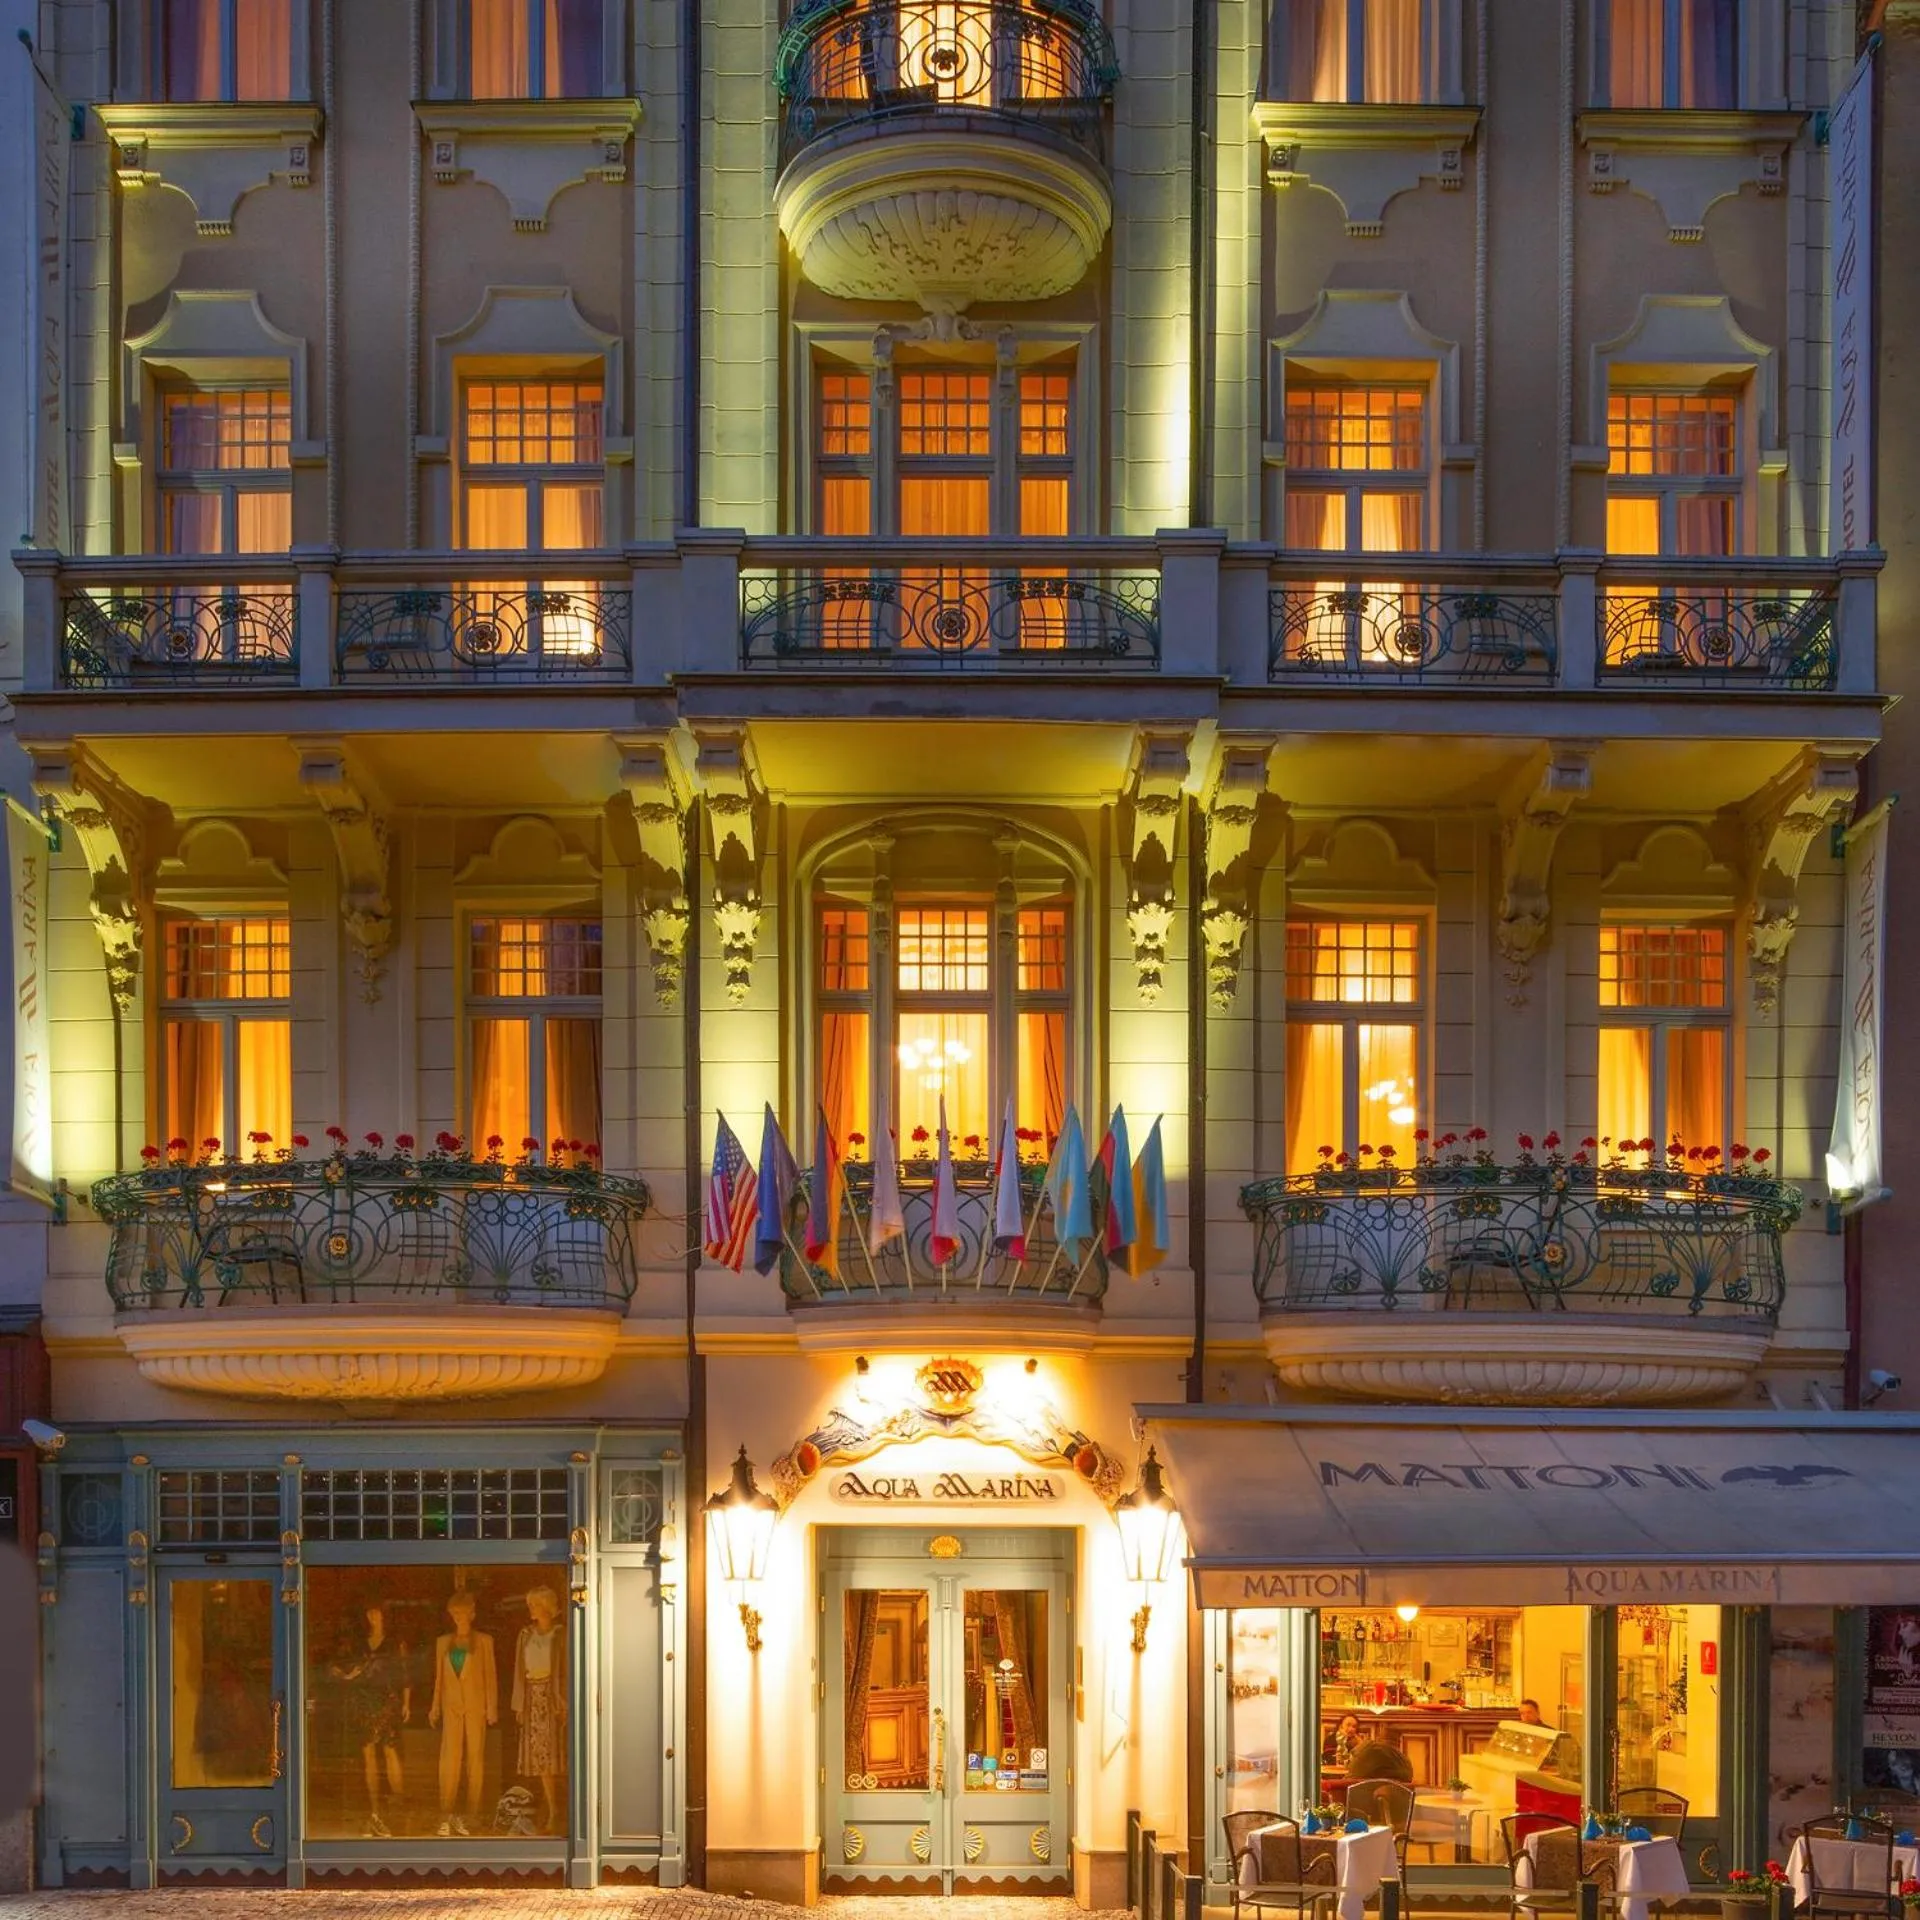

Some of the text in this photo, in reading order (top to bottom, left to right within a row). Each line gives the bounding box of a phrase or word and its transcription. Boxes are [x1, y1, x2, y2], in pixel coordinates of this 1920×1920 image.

[1842, 453, 1855, 549] HOTEL
[838, 1471, 1057, 1501] AQUA MARINA
[1319, 1461, 1716, 1492] MATTONI
[1564, 1568, 1784, 1597] AQUA MARINA
